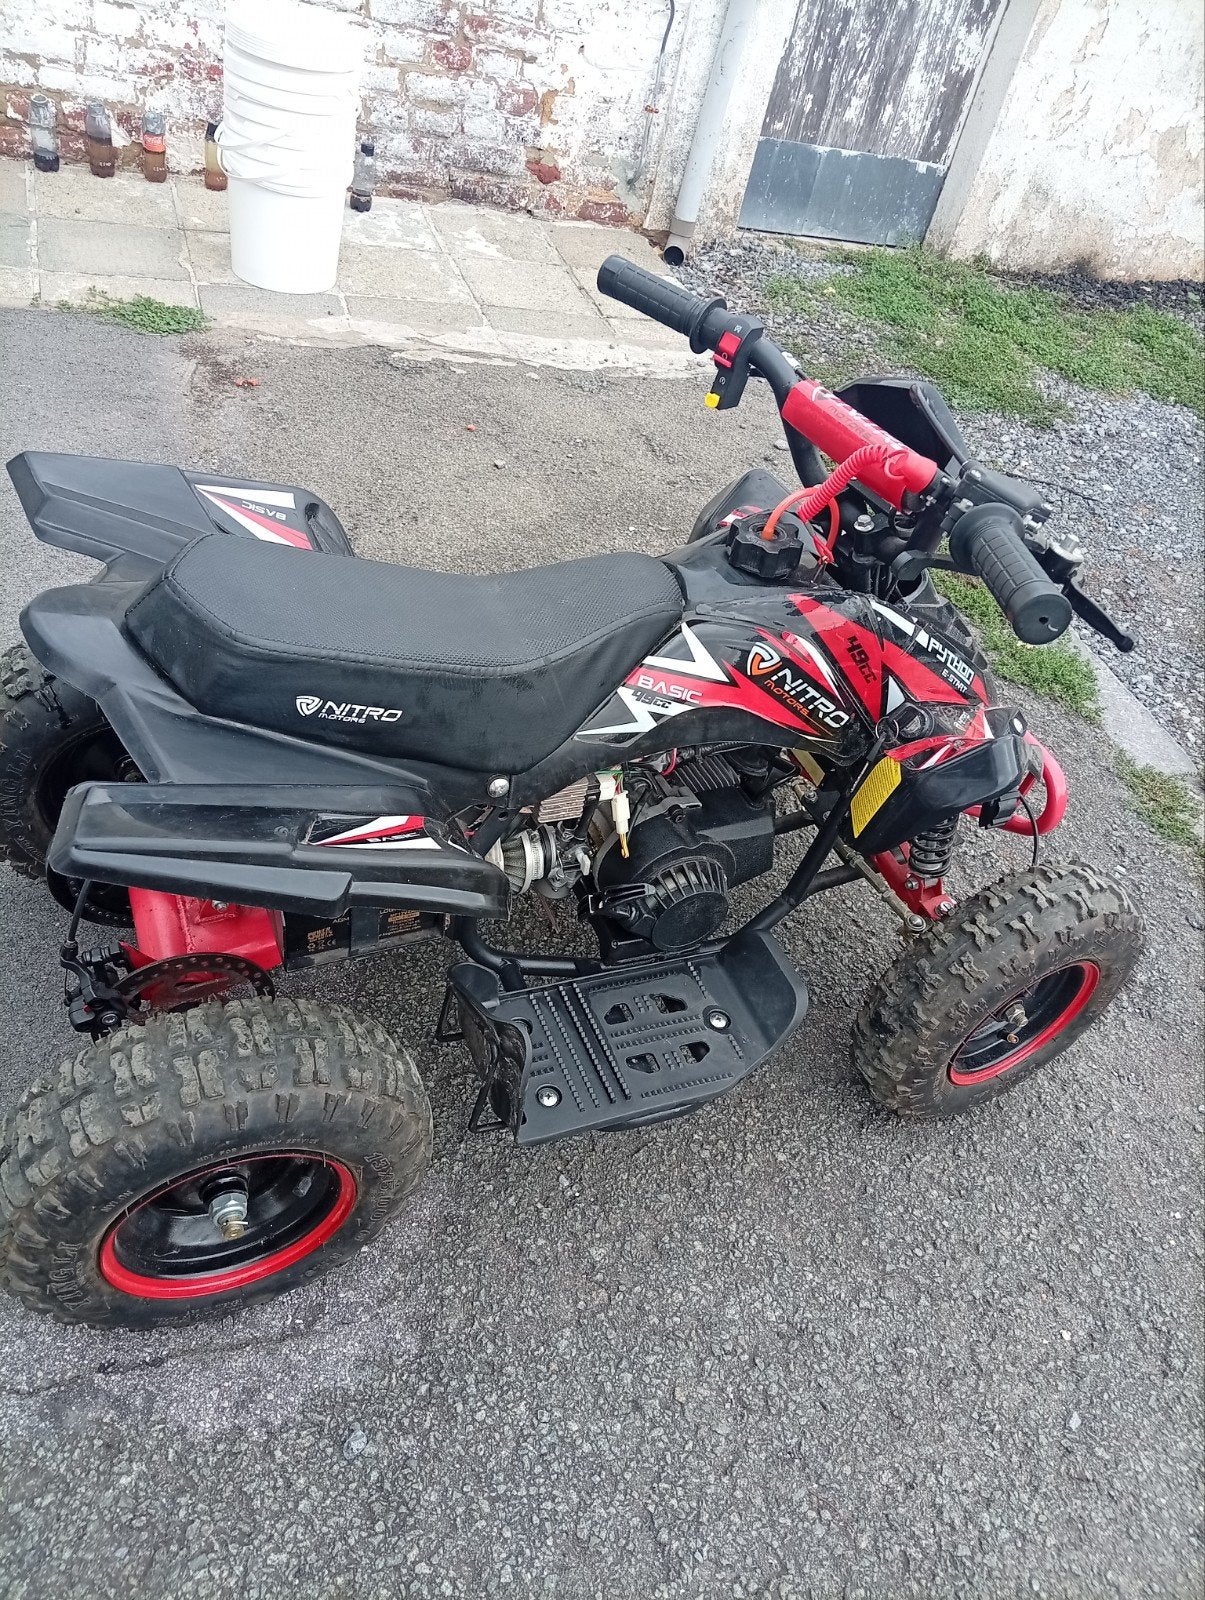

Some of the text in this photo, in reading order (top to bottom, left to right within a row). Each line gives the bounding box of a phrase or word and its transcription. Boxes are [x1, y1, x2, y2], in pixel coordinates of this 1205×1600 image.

[241, 500, 287, 521] BASIC
[927, 636, 975, 686] PYTHON
[637, 674, 703, 704] BASIC
[941, 668, 968, 693] E-START
[321, 700, 403, 722] NITRO
[763, 679, 810, 716] MOTORS
[770, 667, 850, 729] NITRO
[318, 711, 366, 724] MOTORS
